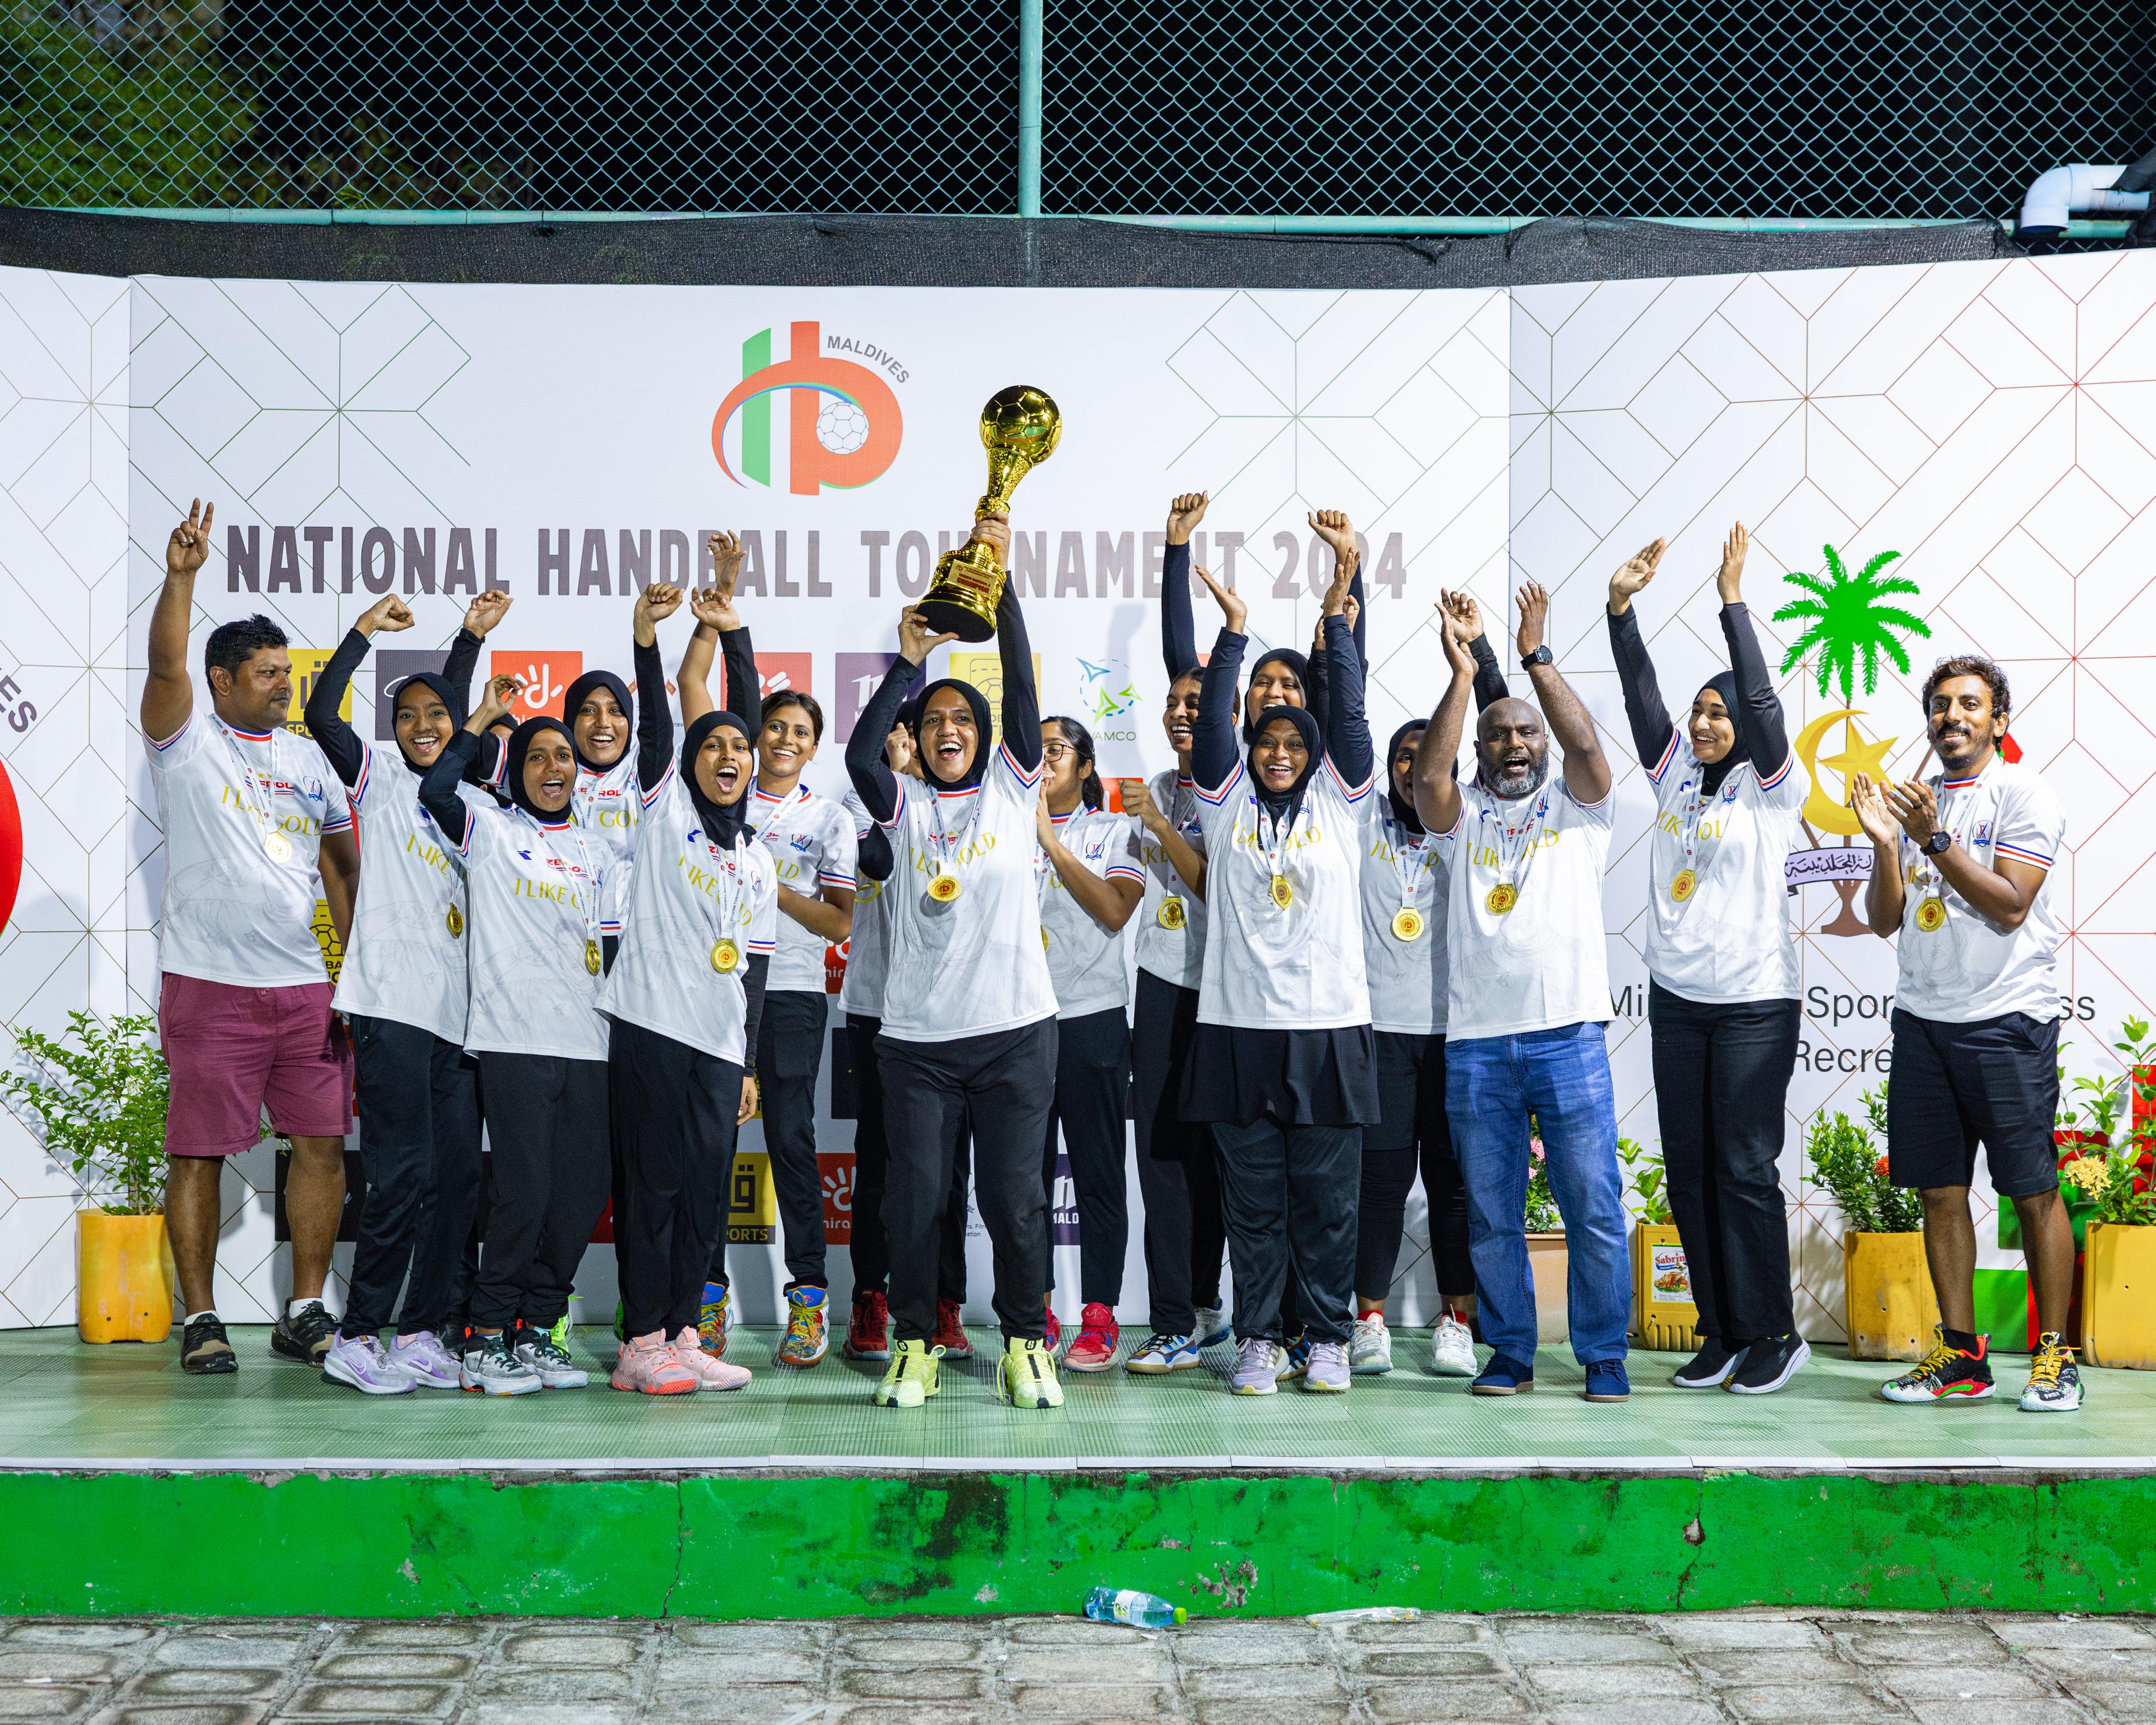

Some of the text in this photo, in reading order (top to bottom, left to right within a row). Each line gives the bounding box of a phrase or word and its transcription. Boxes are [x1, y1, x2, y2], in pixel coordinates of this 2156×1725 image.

[827, 335, 910, 384] MALDIVES
[227, 525, 510, 595] NATIONAL
[1272, 531, 1407, 599] 204
[515, 878, 521, 895] I
[526, 879, 568, 905] LIKE
[688, 864, 718, 897] IKE
[1807, 986, 1895, 1027] Spor
[1797, 1040, 1893, 1073] Recre
[727, 1227, 769, 1241] ORTS
[1655, 1254, 1685, 1265] Sabrin
